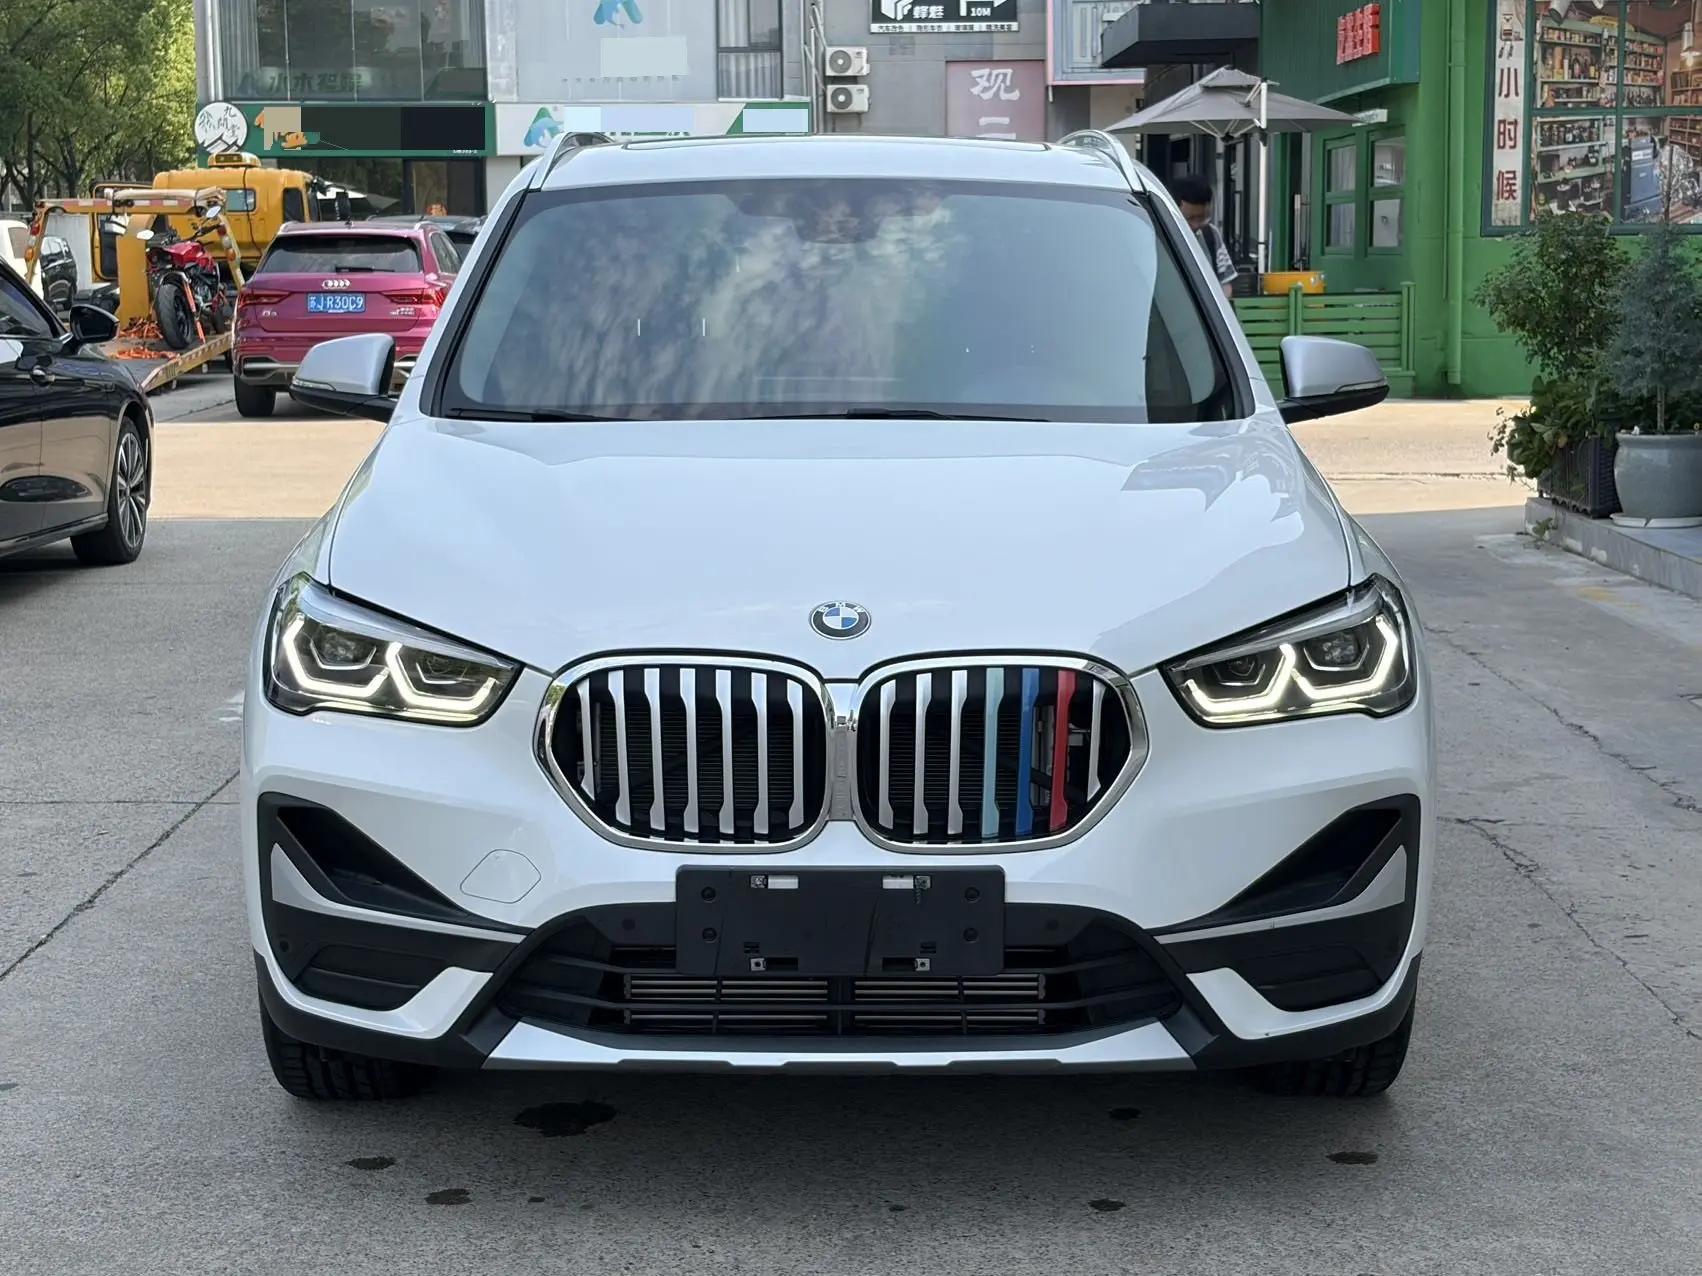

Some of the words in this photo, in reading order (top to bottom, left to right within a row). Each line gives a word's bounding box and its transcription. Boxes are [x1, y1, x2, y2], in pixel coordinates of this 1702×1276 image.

[970, 7, 992, 17] 10M
[1496, 66, 1520, 201] 小时候
